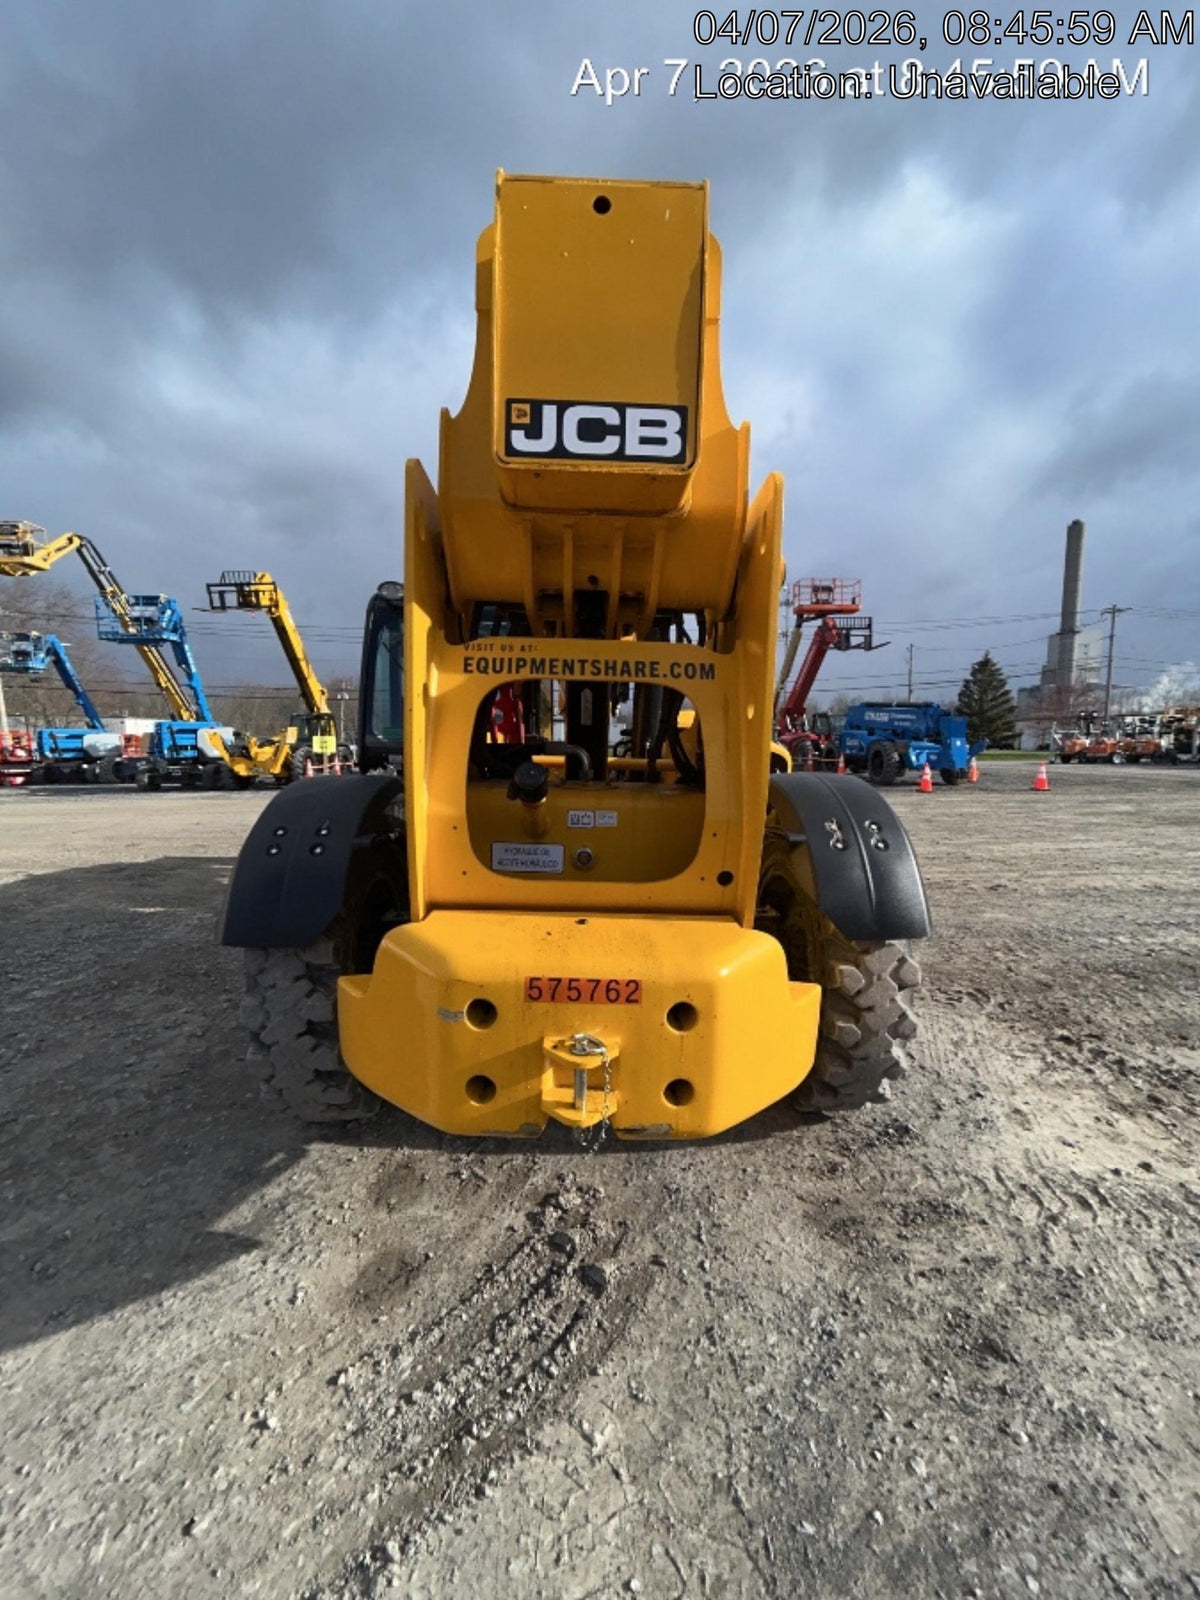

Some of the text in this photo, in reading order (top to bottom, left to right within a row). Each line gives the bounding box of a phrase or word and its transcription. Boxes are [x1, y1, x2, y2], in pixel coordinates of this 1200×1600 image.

[510, 404, 682, 458] JCB
[464, 643, 494, 652] VISIT
[501, 643, 514, 652] US
[463, 656, 716, 680] EQUIPMENTSHARE.COM
[527, 977, 640, 1003] 575762
